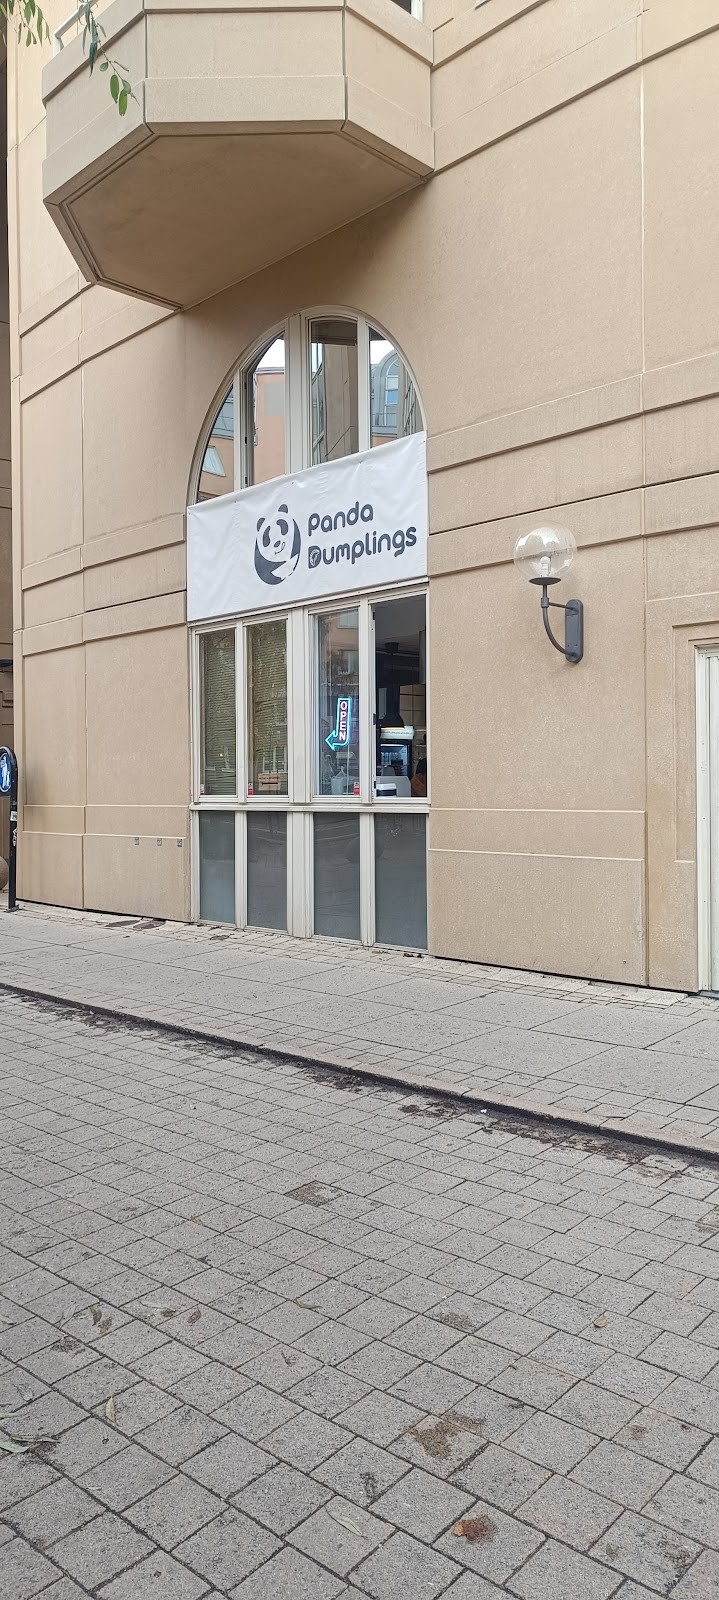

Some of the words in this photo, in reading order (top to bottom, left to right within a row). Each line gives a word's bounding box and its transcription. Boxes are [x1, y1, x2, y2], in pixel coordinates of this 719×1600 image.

[308, 502, 373, 536] Panda
[308, 527, 417, 568] Dumplings
[339, 701, 348, 741] OPEN
